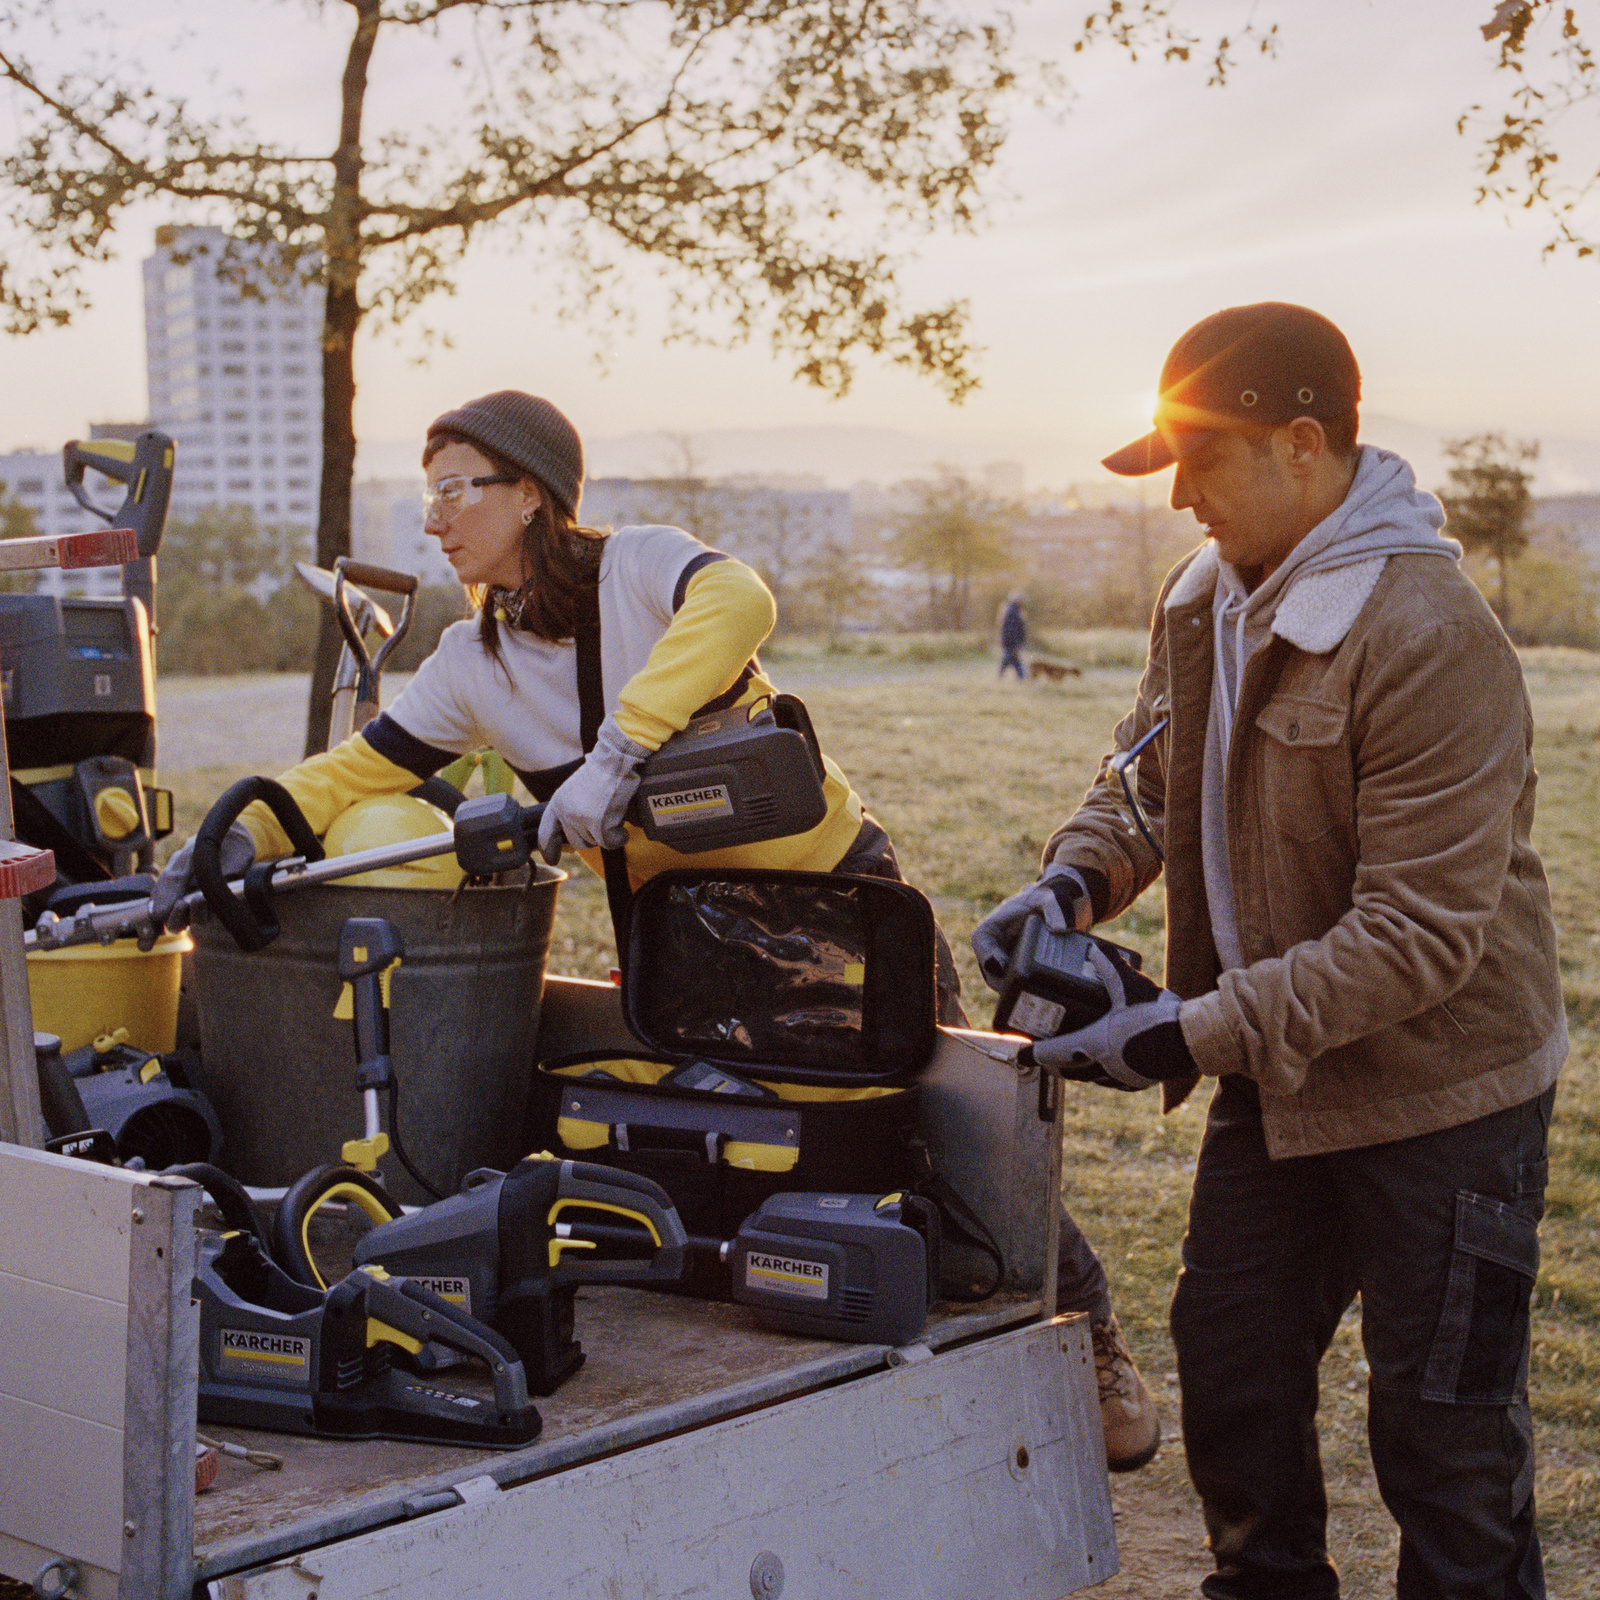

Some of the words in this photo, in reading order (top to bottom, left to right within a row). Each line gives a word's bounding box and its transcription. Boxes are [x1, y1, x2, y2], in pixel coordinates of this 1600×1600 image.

[652, 788, 723, 808] KÄRCHER
[750, 1255, 823, 1277] KÄRCHER
[223, 1332, 304, 1354] KÄRCHER
